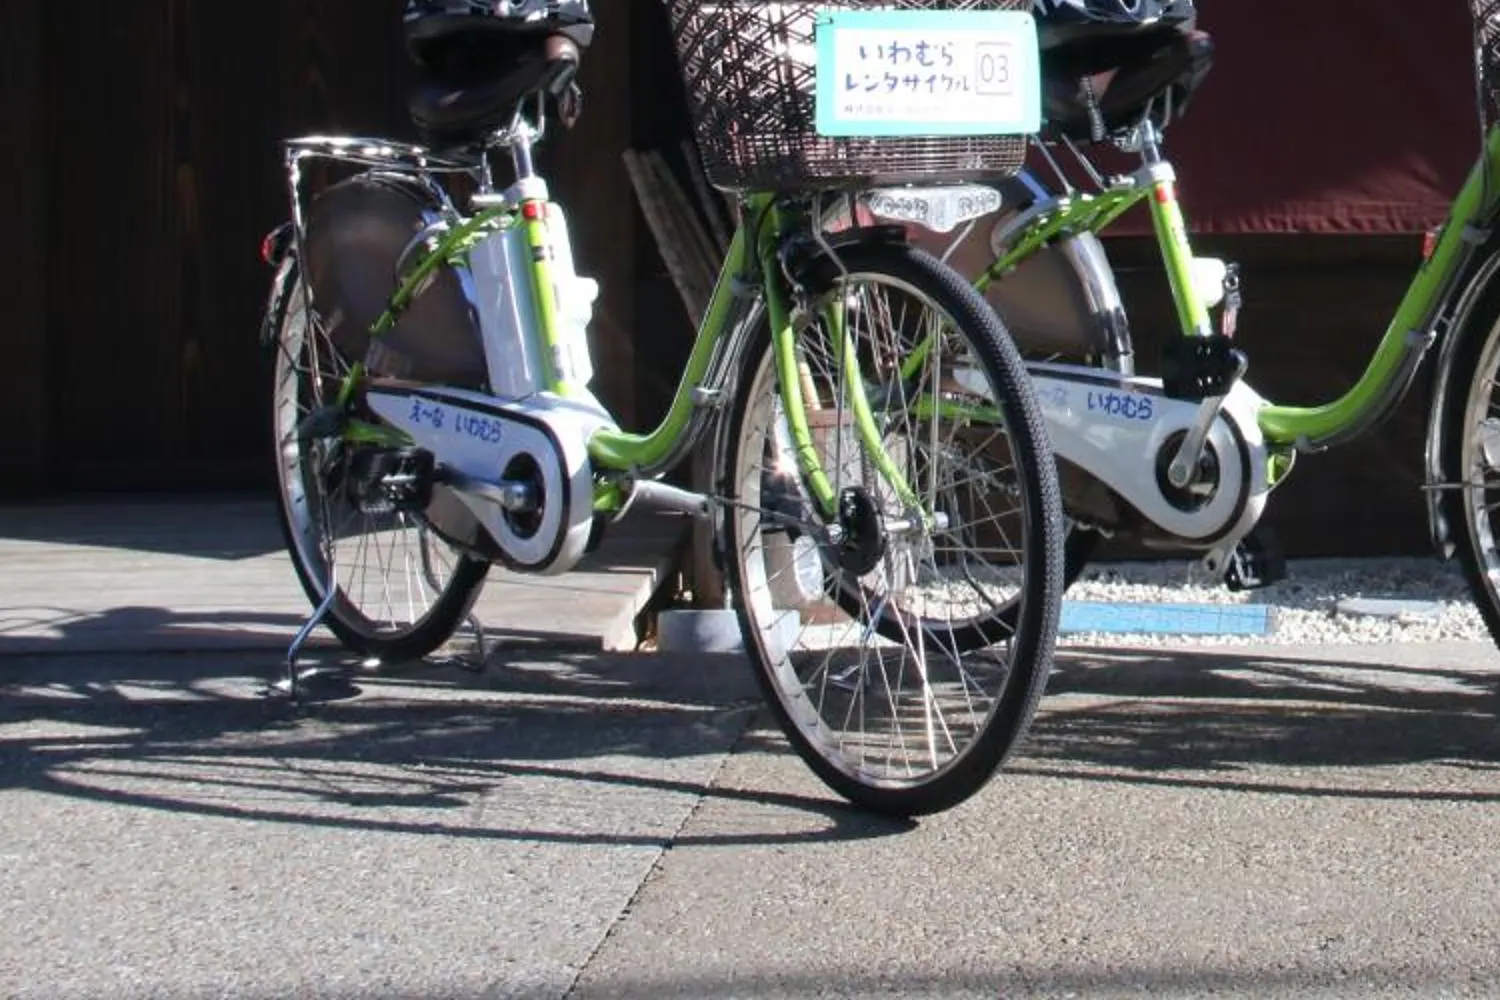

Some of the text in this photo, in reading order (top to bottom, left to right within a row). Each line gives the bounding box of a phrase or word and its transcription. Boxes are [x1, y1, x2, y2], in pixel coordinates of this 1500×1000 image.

[859, 39, 955, 67] いわむら
[979, 53, 1010, 84] 03
[845, 71, 971, 94] レンタサイクル
[1087, 390, 1153, 421] いわむら
[455, 412, 503, 444] いわむら
